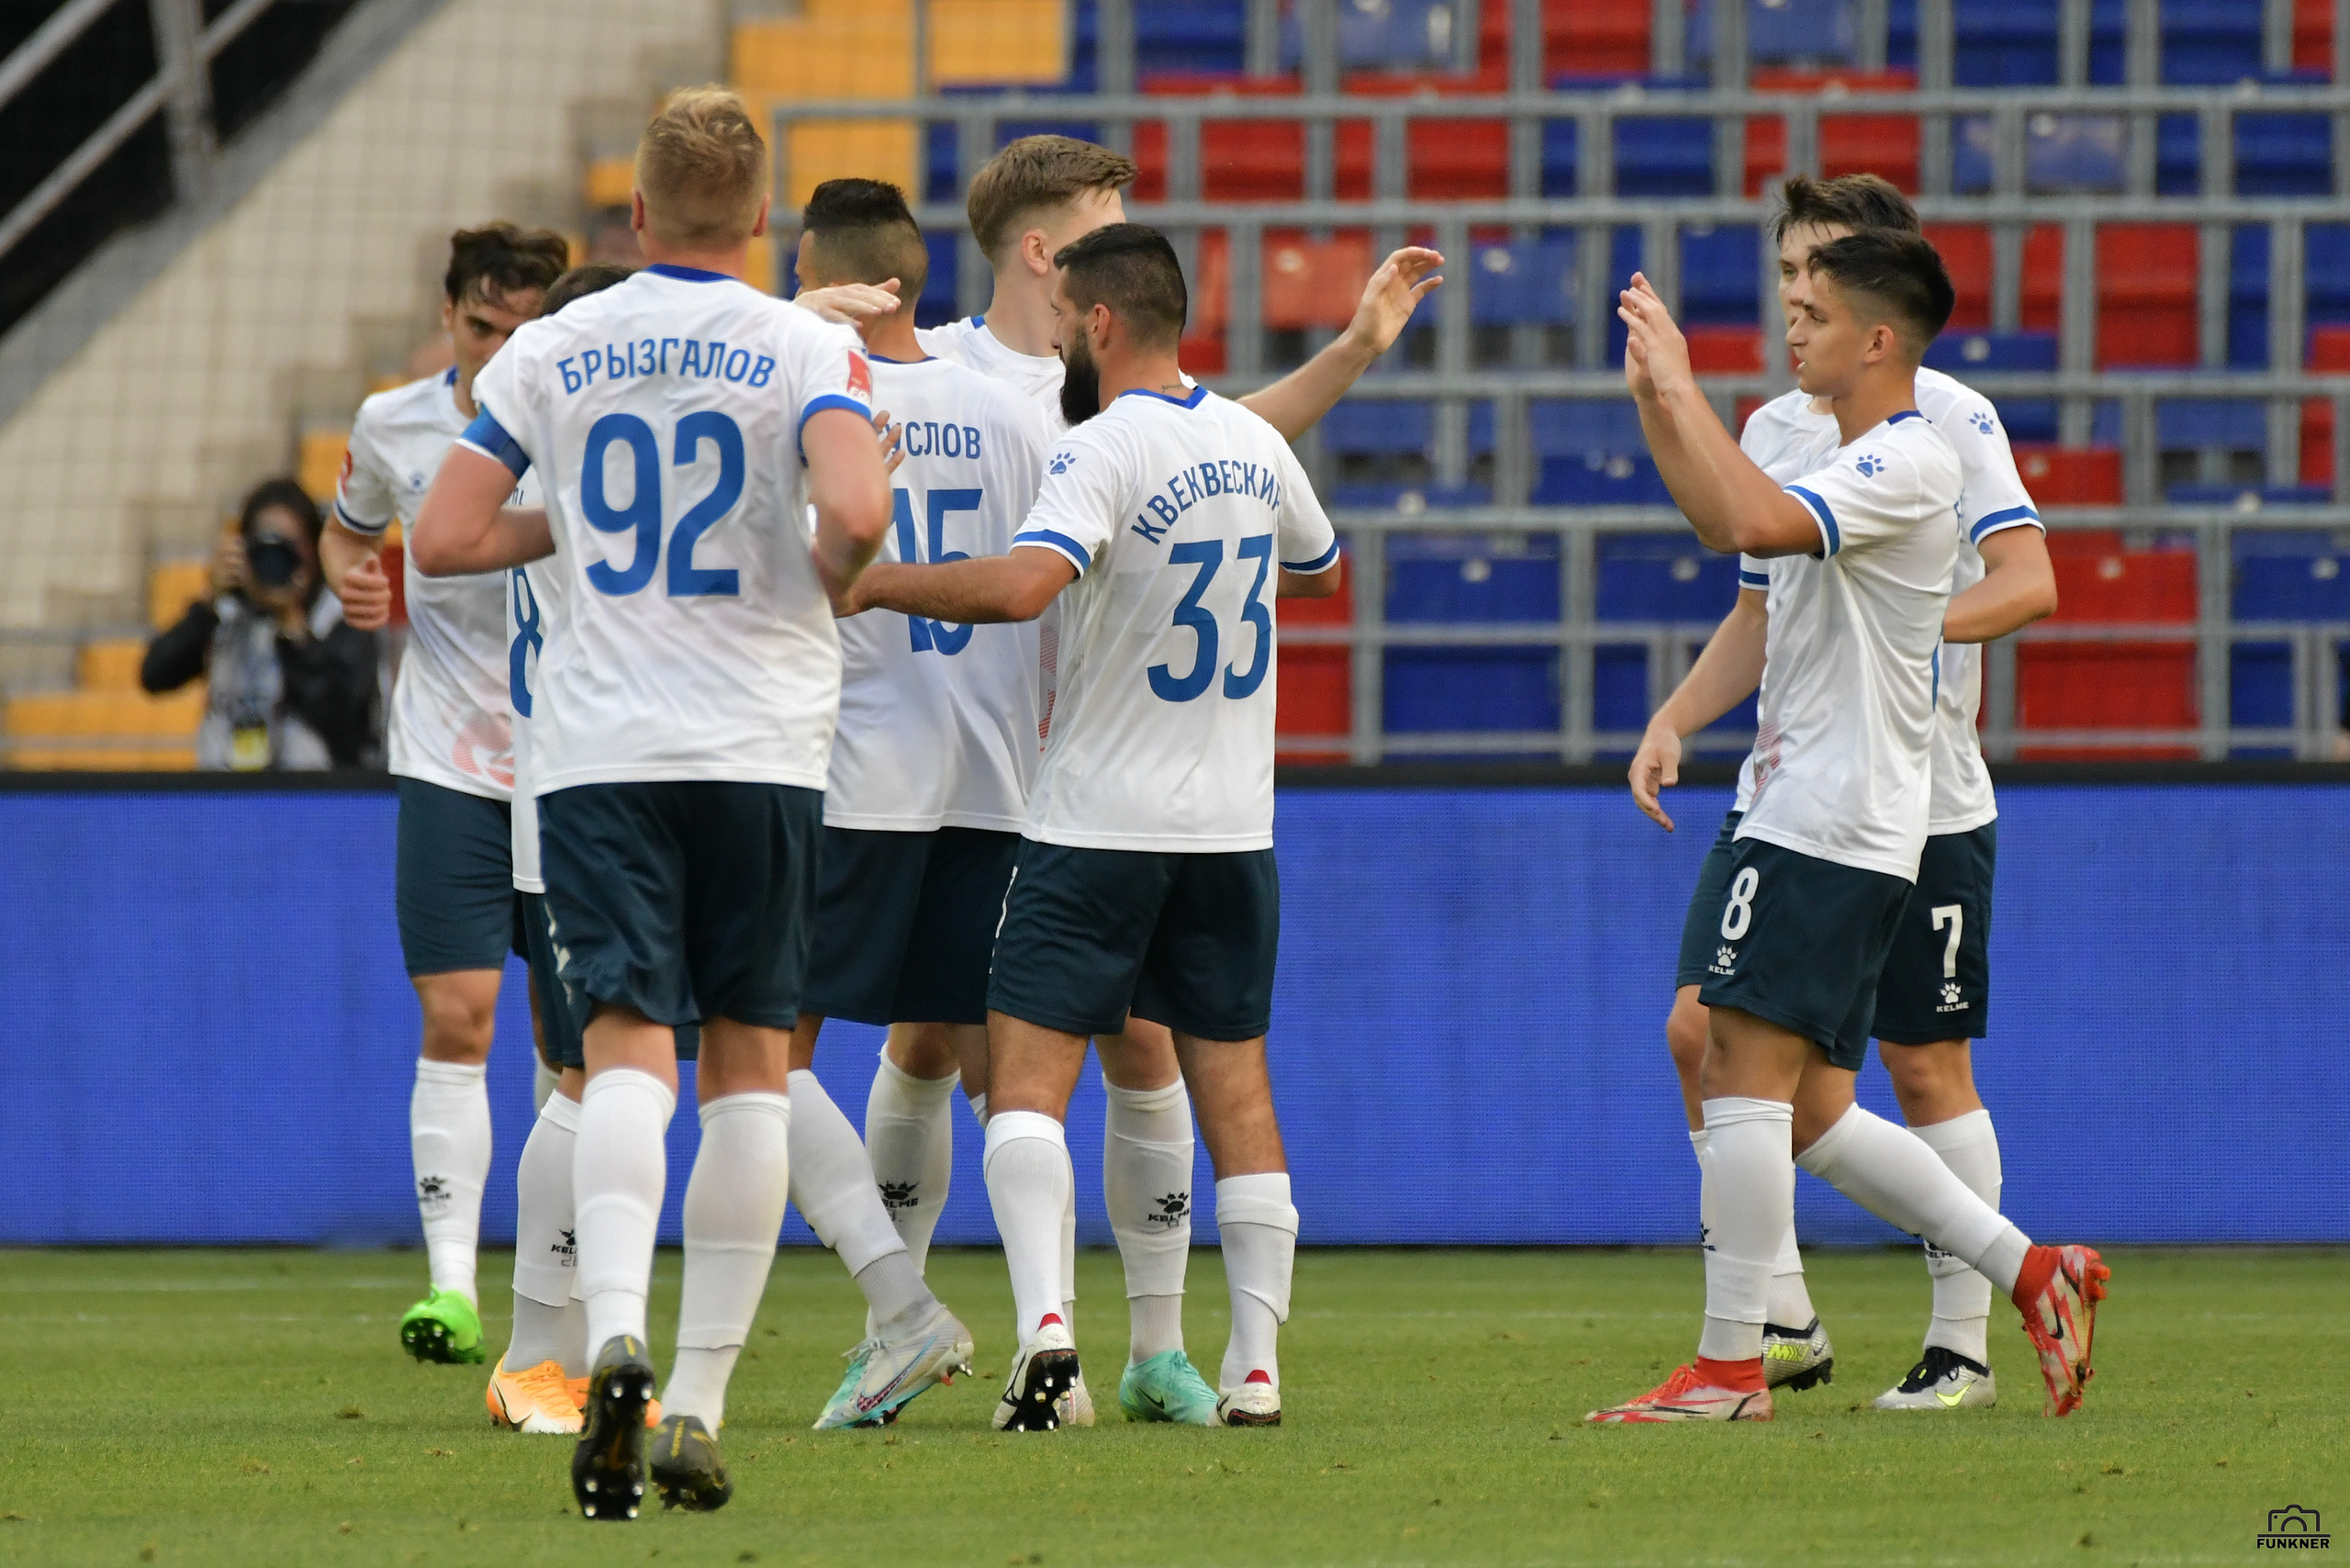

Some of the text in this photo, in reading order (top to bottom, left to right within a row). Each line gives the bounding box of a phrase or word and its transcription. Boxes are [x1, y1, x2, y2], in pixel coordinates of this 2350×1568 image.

[556, 338, 776, 395] БРЫЗГАЛОВ
[580, 411, 745, 597] 92
[887, 487, 983, 655] 15
[1147, 533, 1273, 702] 33
[1721, 867, 1760, 941] 8
[1931, 903, 1964, 979] 7
[1935, 1001, 1970, 1014] KELME
[551, 1244, 577, 1255] KEL
